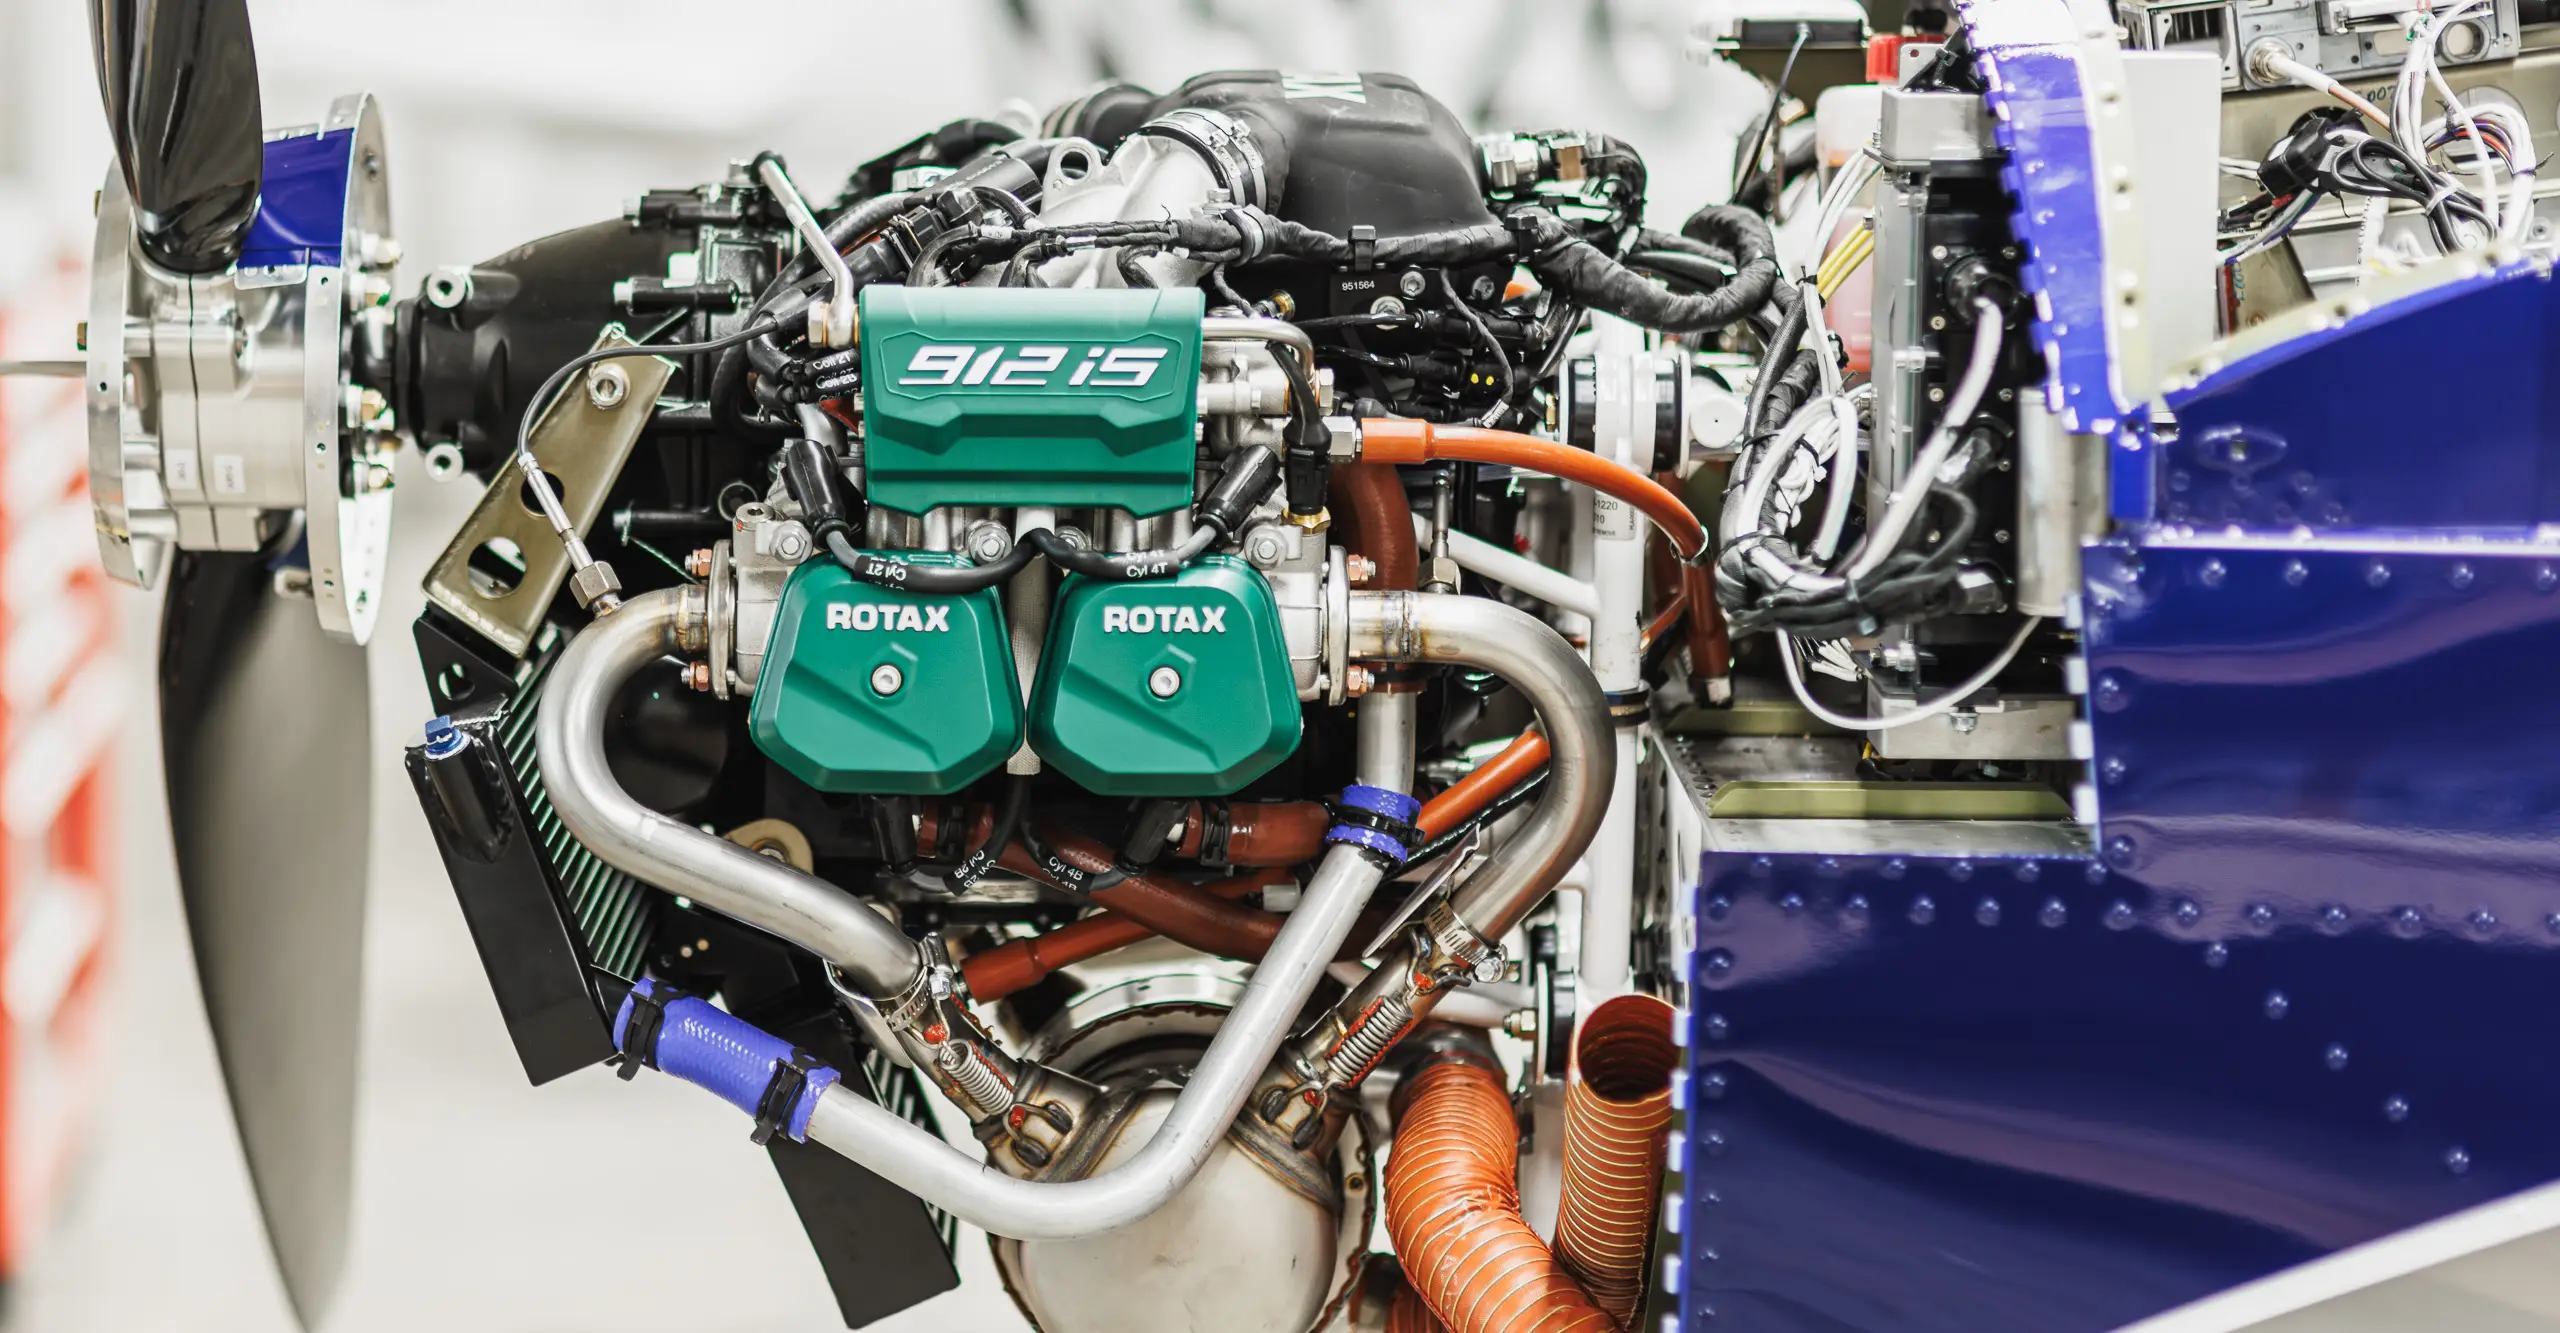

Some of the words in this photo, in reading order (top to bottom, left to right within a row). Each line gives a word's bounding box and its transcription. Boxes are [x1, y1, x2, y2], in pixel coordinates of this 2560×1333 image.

[1341, 280, 1375, 291] 951564
[812, 356, 837, 370] Coil
[898, 345, 1069, 386] 912
[865, 562, 885, 577] 2T
[885, 563, 907, 581] Cyl
[1126, 563, 1148, 578] Cyl
[1151, 561, 1168, 575] 4T
[826, 602, 950, 632] ROTAX
[1103, 605, 1227, 634] ROTAX
[1048, 856, 1067, 873] Cyl
[1067, 867, 1084, 881] 4B
